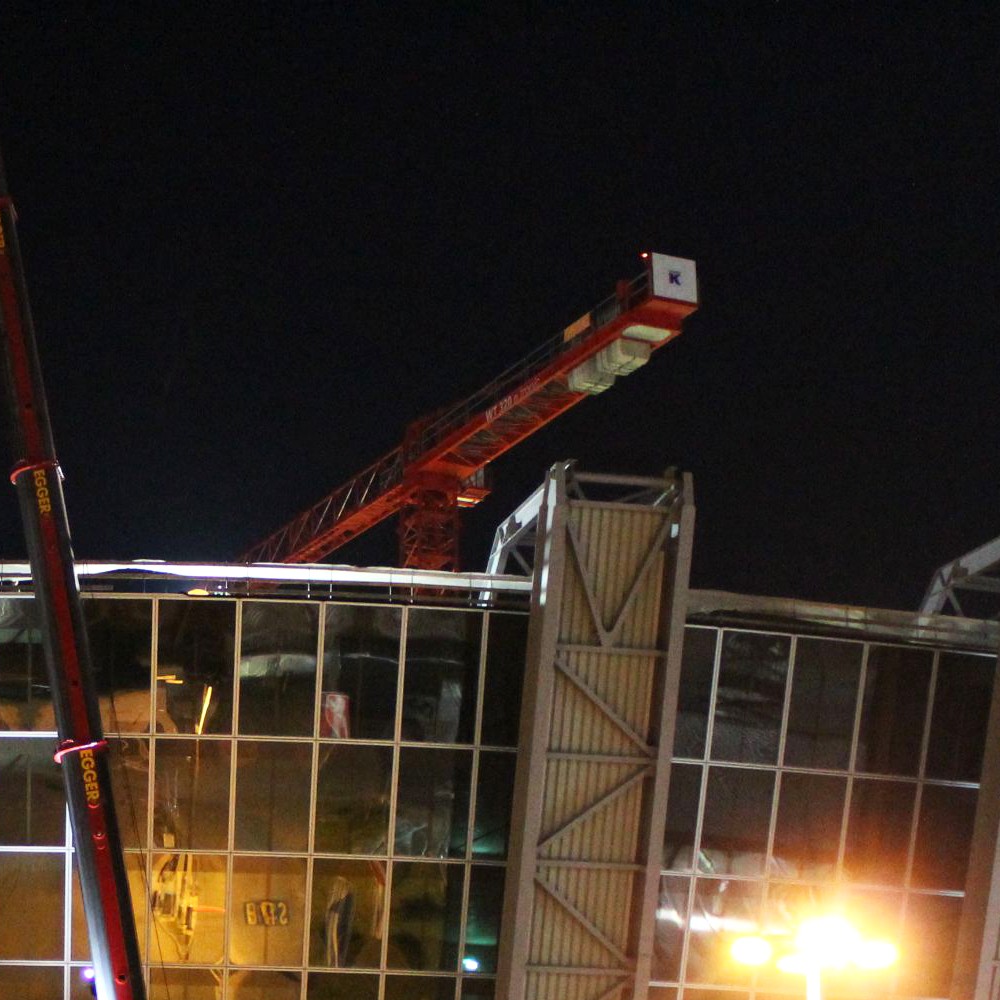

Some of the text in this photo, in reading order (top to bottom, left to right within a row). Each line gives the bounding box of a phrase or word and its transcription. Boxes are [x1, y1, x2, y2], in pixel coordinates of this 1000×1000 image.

[668, 270, 682, 286] K
[34, 469, 52, 514] EGGER
[80, 749, 100, 801] EGGER
